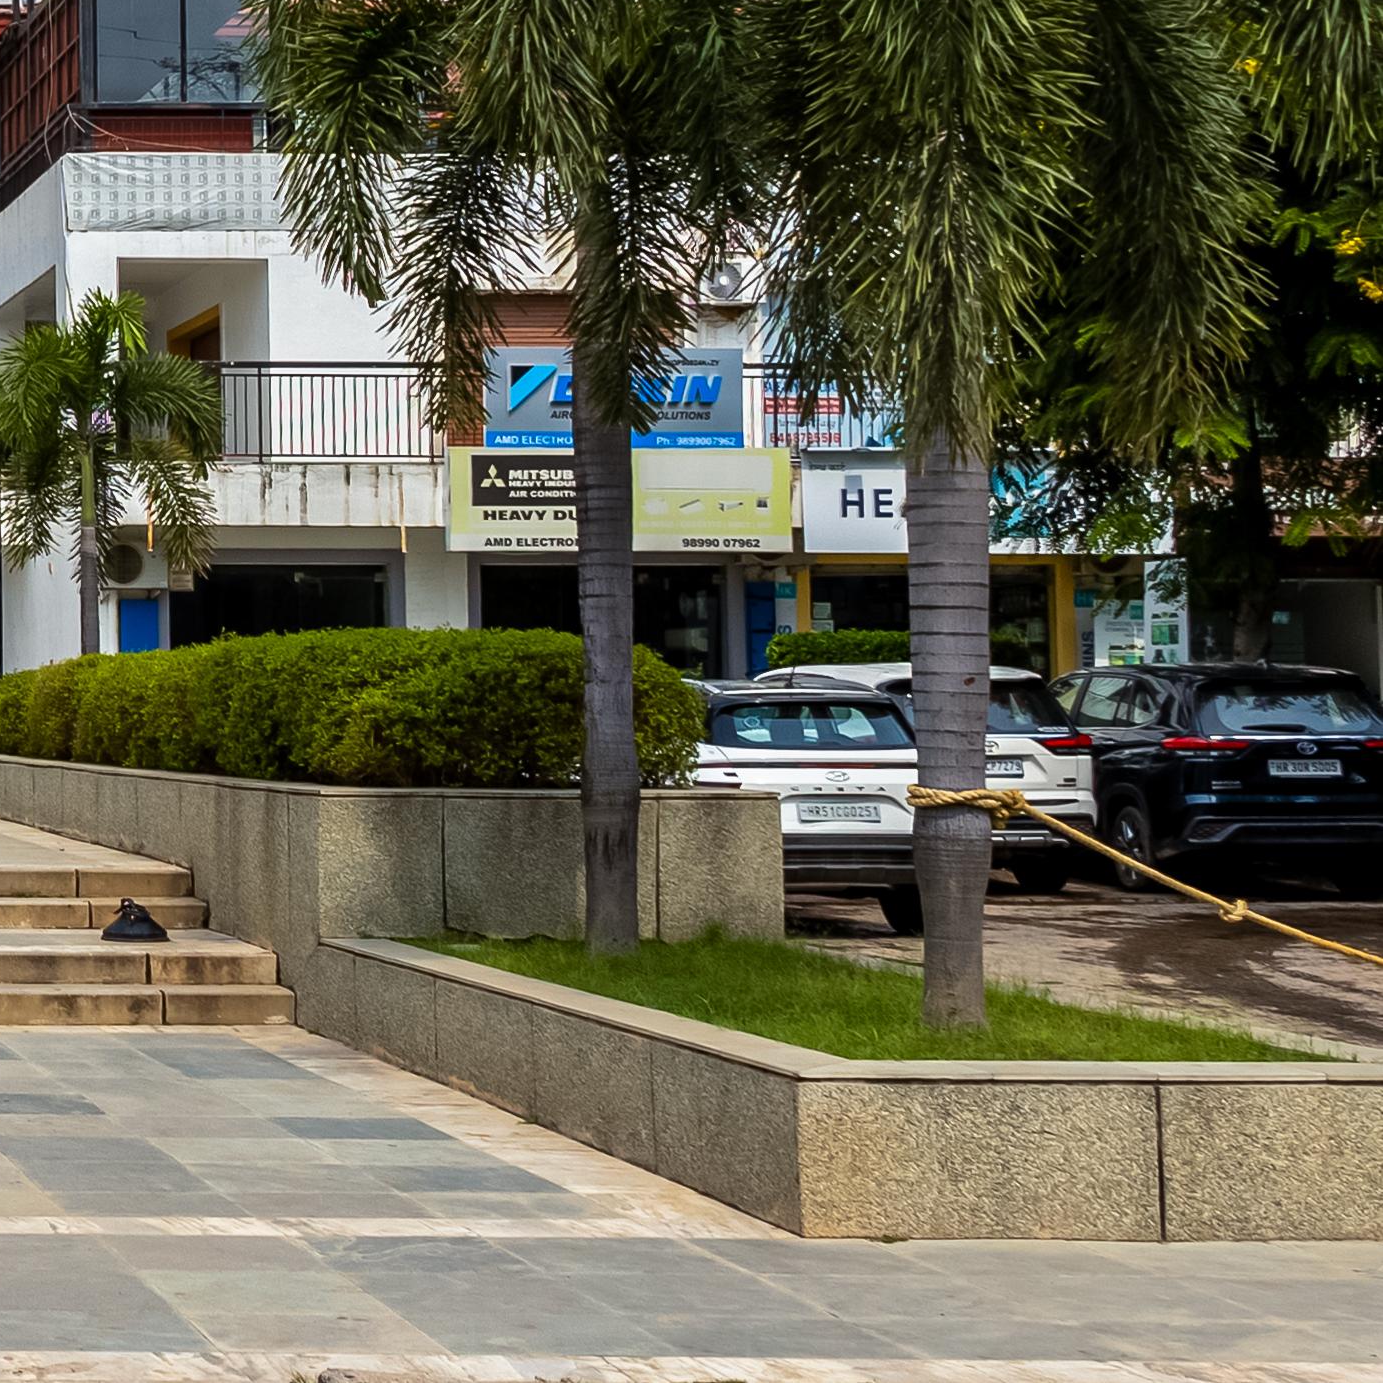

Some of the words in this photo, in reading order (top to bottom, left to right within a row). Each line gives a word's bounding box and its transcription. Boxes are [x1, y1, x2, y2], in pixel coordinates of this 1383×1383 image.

[655, 410, 711, 420] OLUTIONS
[494, 436, 518, 444] AMD
[483, 510, 546, 520] HEAVY
[485, 538, 512, 546] AMD
[682, 539, 720, 547] 98990
[723, 539, 760, 547] 07962
